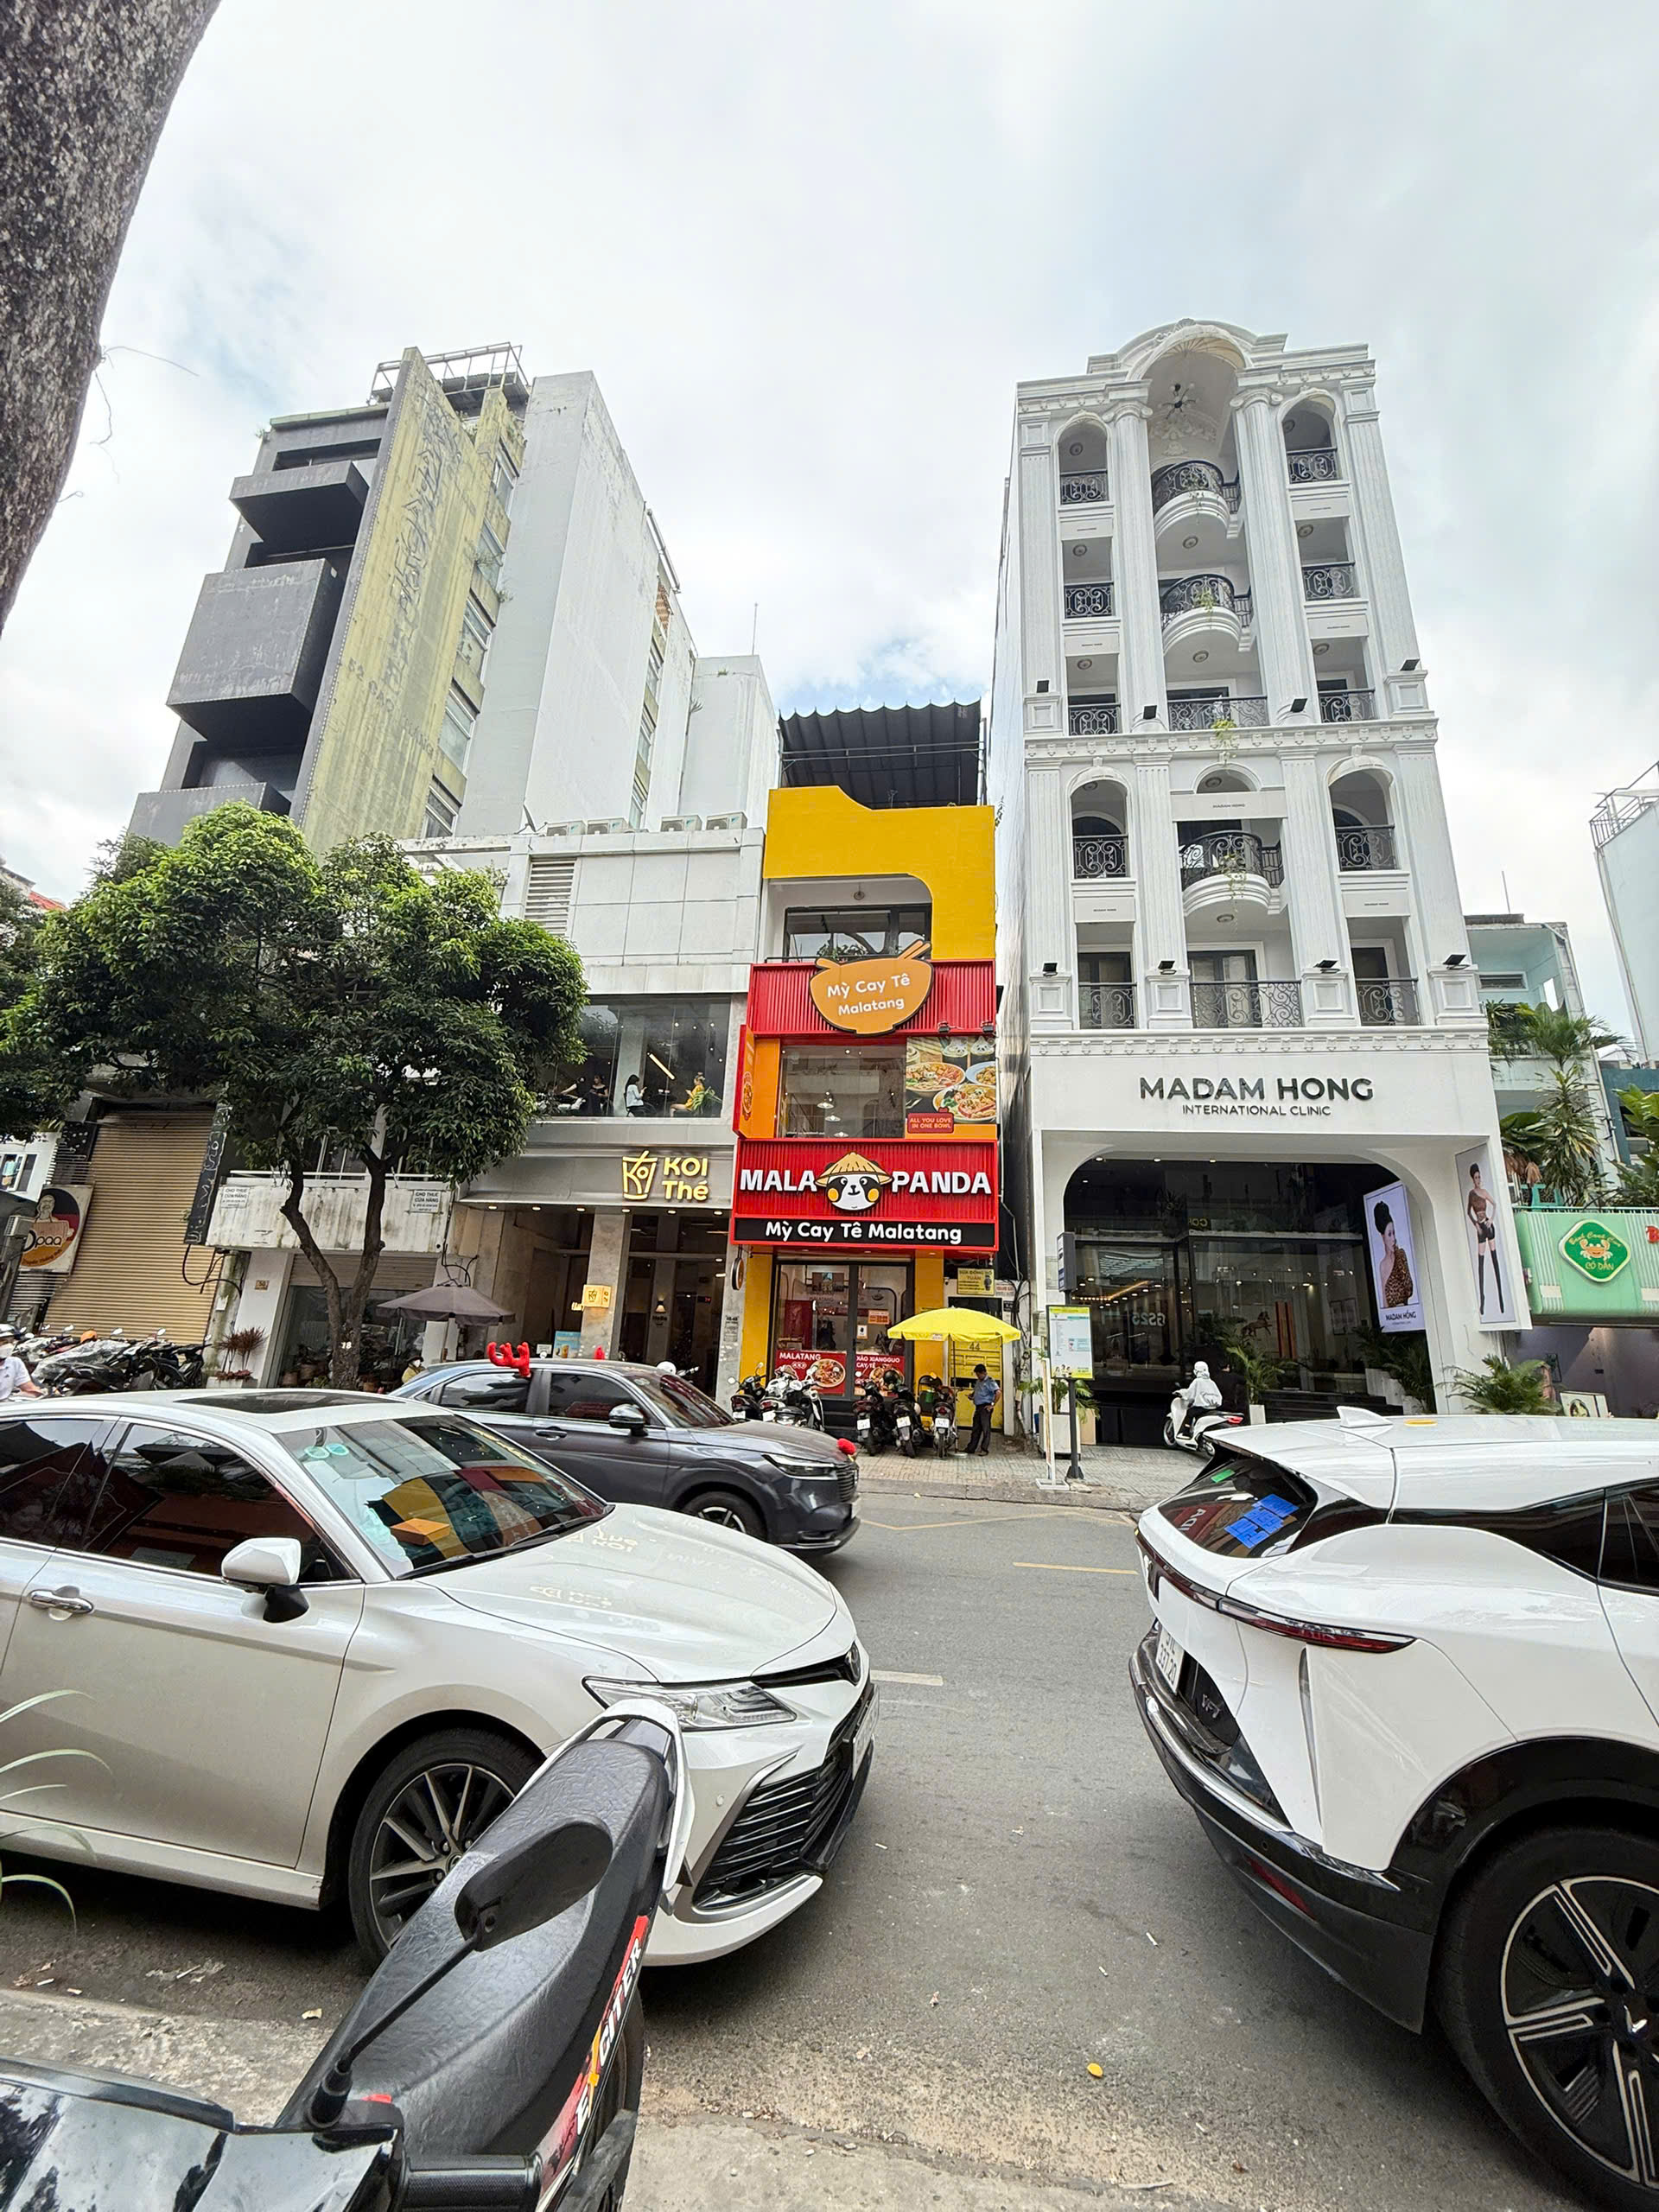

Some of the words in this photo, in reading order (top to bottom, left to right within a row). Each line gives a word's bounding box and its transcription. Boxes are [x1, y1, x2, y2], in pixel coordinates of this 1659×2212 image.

[827, 982, 850, 999] Mỳ
[855, 980, 886, 993] Cay
[891, 972, 911, 988] Tê
[838, 998, 905, 1016] Malatang
[1140, 1077, 1264, 1100] MADAM
[1277, 1077, 1374, 1101] HONG
[1182, 1104, 1287, 1116] INTERNATIONAL
[1290, 1105, 1332, 1116] CLINIC
[663, 1157, 709, 1177] KOI
[661, 1179, 709, 1201] Thé
[740, 1169, 817, 1192] MALA
[892, 1172, 992, 1194] PANDA
[766, 1221, 791, 1242] Mỳ
[798, 1223, 834, 1242] Cay
[841, 1223, 862, 1237] Tê
[868, 1224, 962, 1244] Malatang
[969, 1342, 981, 1351] 44
[575, 1937, 642, 2136] EXCITER
